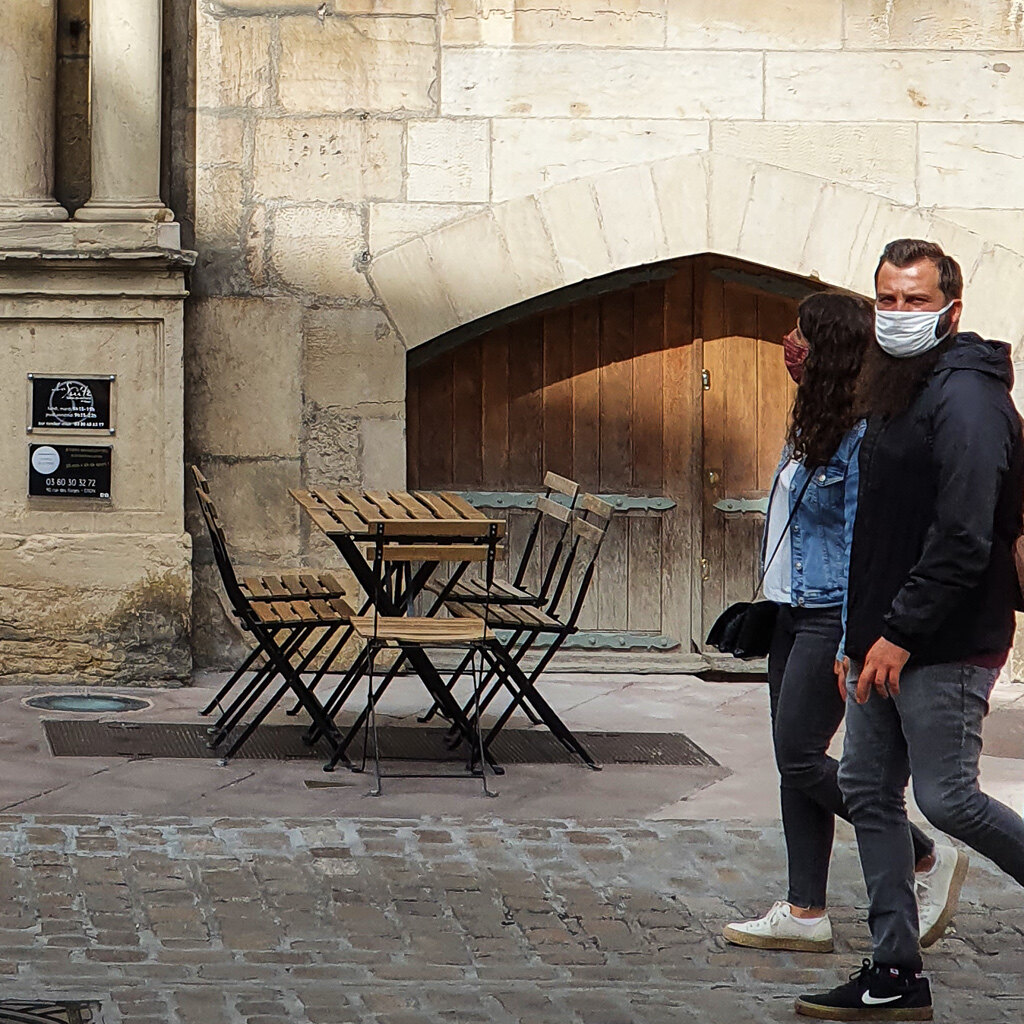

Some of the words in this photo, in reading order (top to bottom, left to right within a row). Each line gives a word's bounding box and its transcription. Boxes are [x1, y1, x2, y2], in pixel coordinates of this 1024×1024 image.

[45, 477, 56, 487] 03
[67, 478, 77, 487] 30
[78, 478, 88, 487] 32
[87, 478, 97, 487] 72
